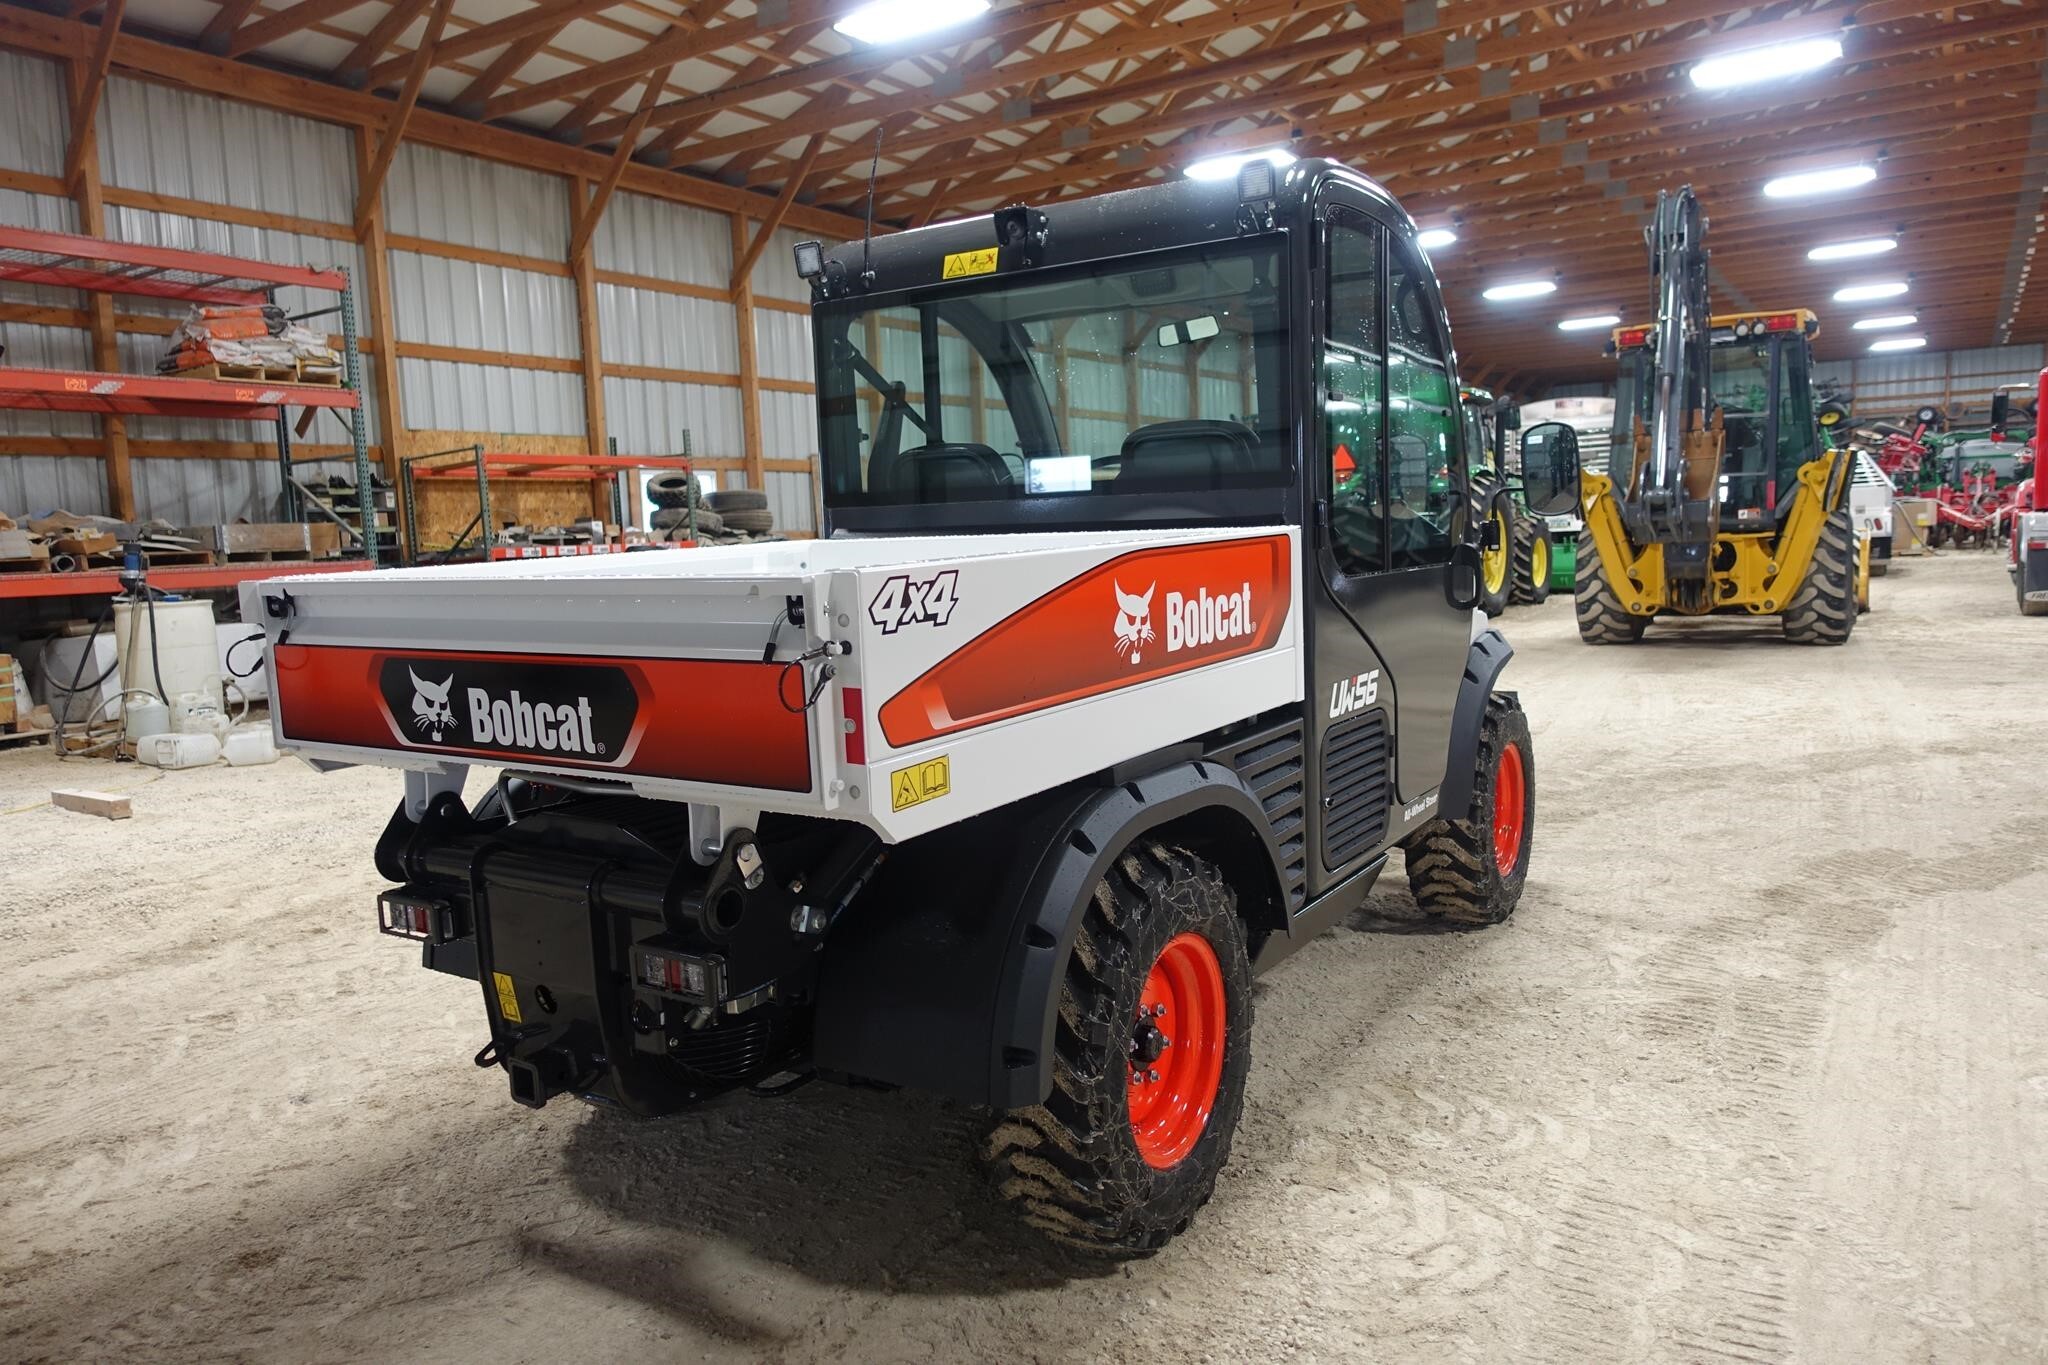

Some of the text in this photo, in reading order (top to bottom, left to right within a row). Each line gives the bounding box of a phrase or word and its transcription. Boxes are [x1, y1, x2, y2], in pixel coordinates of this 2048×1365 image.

[868, 570, 959, 635] 4x4
[1166, 582, 1252, 652] Bobcat
[467, 687, 596, 754] Bobcat
